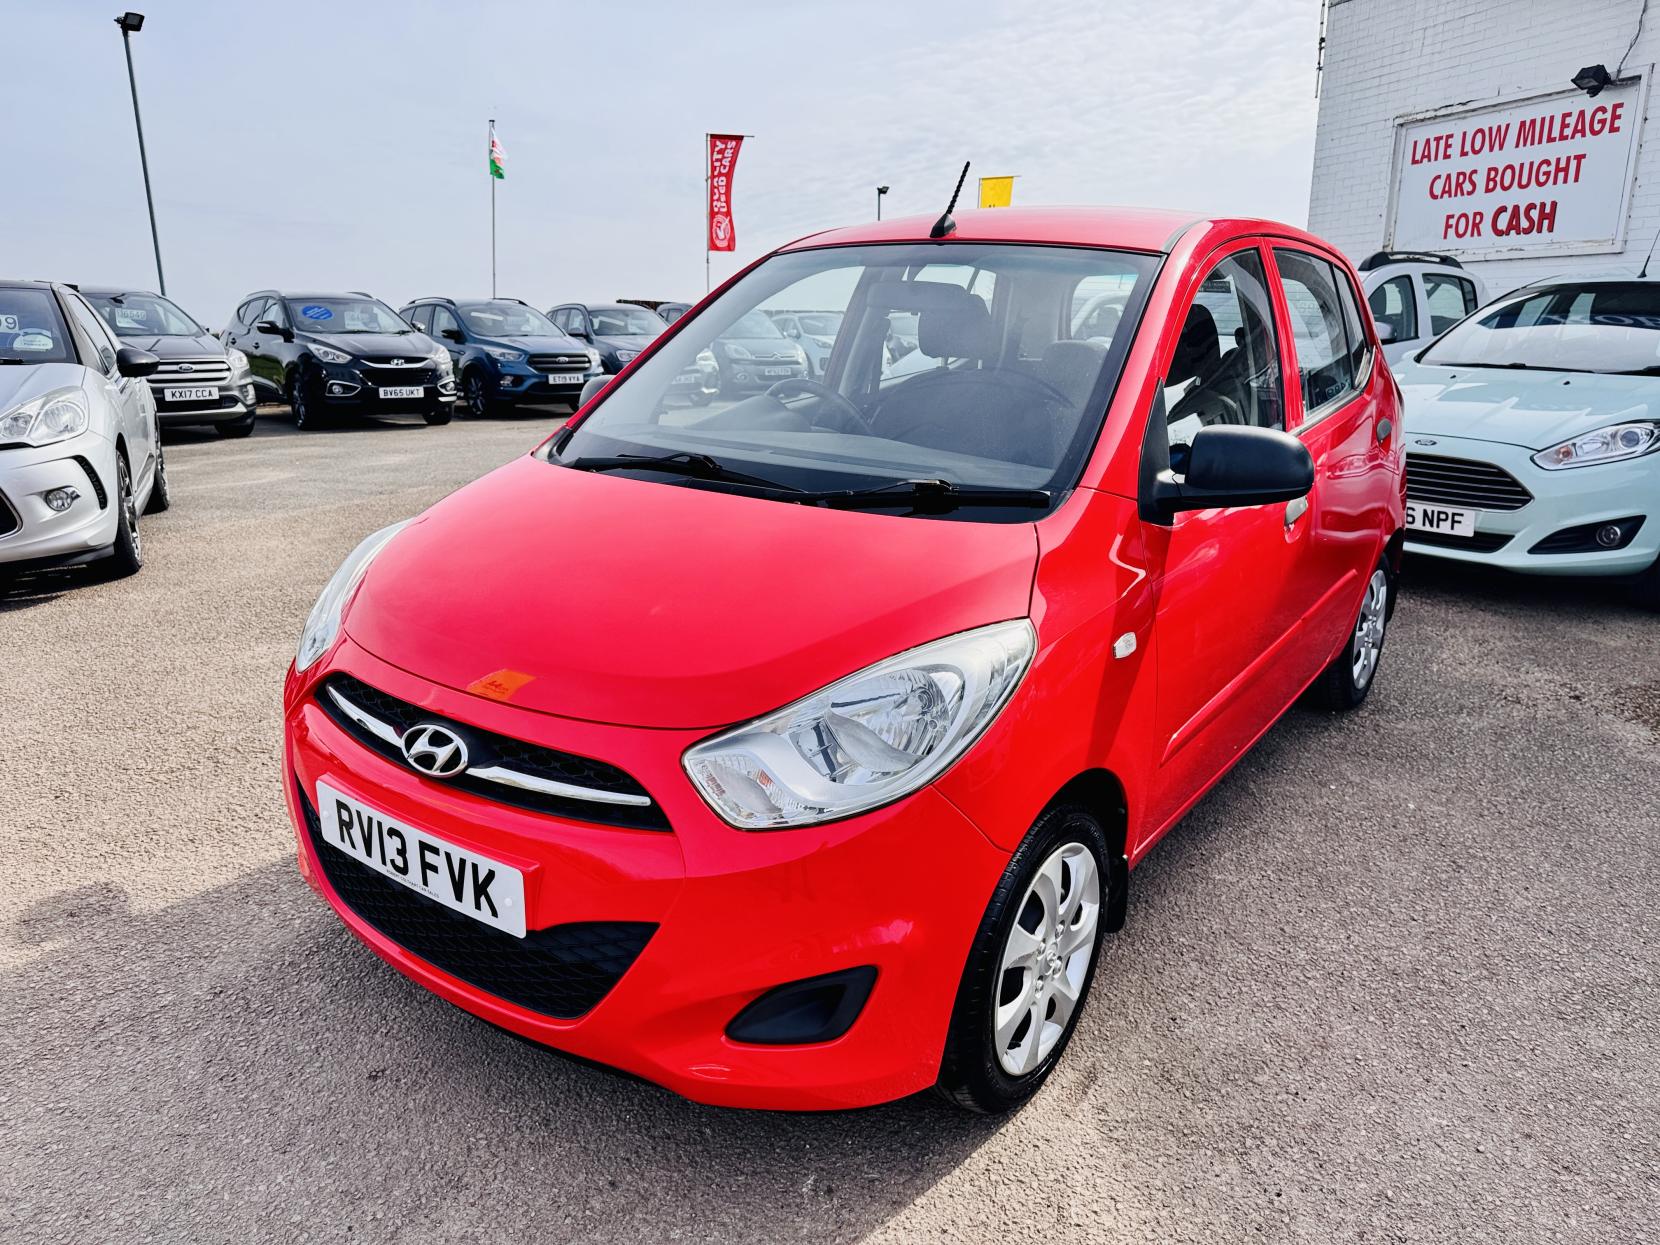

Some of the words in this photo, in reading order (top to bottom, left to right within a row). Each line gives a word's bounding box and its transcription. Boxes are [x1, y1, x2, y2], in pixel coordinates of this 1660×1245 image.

[1411, 133, 1454, 165] LATE
[1459, 123, 1510, 158] LOW
[1514, 102, 1625, 149] MILEAGE
[720, 141, 737, 173] CARS
[718, 176, 728, 212] USED
[1429, 169, 1478, 200] CARS
[1484, 153, 1587, 194] BOUGHT
[1443, 211, 1484, 240] FOR
[1491, 200, 1558, 237] CASH
[171, 389, 193, 399] KX17
[195, 389, 214, 398] CCA
[383, 388, 404, 397] BV65
[405, 388, 421, 397] UKT
[1421, 508, 1464, 531] NPF
[335, 798, 409, 876] RV13
[418, 839, 499, 919] FVK
